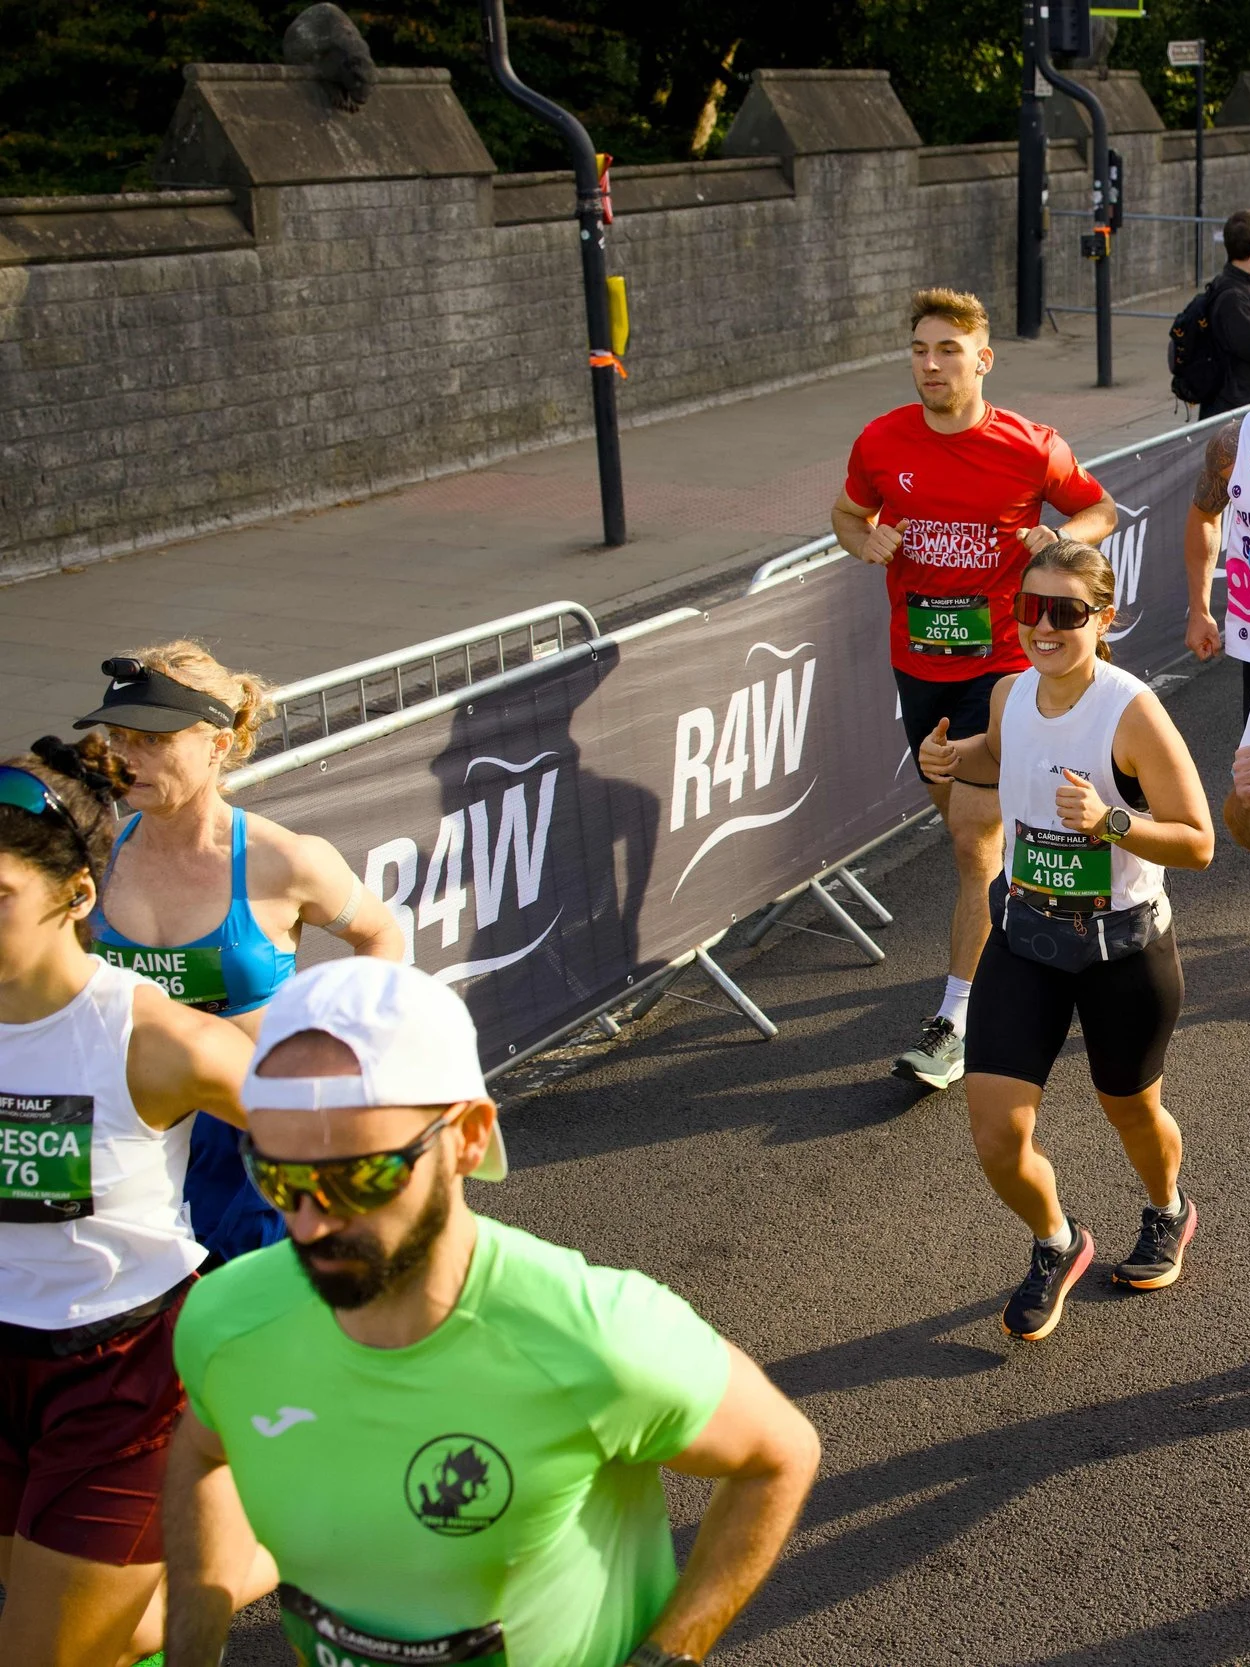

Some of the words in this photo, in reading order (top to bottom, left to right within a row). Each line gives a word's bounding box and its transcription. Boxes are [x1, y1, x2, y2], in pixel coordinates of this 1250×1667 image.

[902, 529, 987, 555] EDWARDS
[931, 613, 959, 626] JOE
[925, 626, 969, 640] 26740
[669, 657, 817, 833] R4W
[1037, 832, 1066, 843] CARDIFF
[364, 767, 559, 966] R4W
[1027, 848, 1083, 870] PAULA
[1032, 868, 1076, 889] 4186
[106, 950, 188, 973] ELAINE
[17, 1099, 52, 1111] HALF
[0, 1128, 81, 1158] ESCA
[1, 1159, 40, 1187] 76
[12, 1190, 39, 1199] FEMALE
[41, 1191, 71, 1199] MEDIUM
[338, 1626, 399, 1654] CARDIFF
[403, 1640, 449, 1657] HALF
